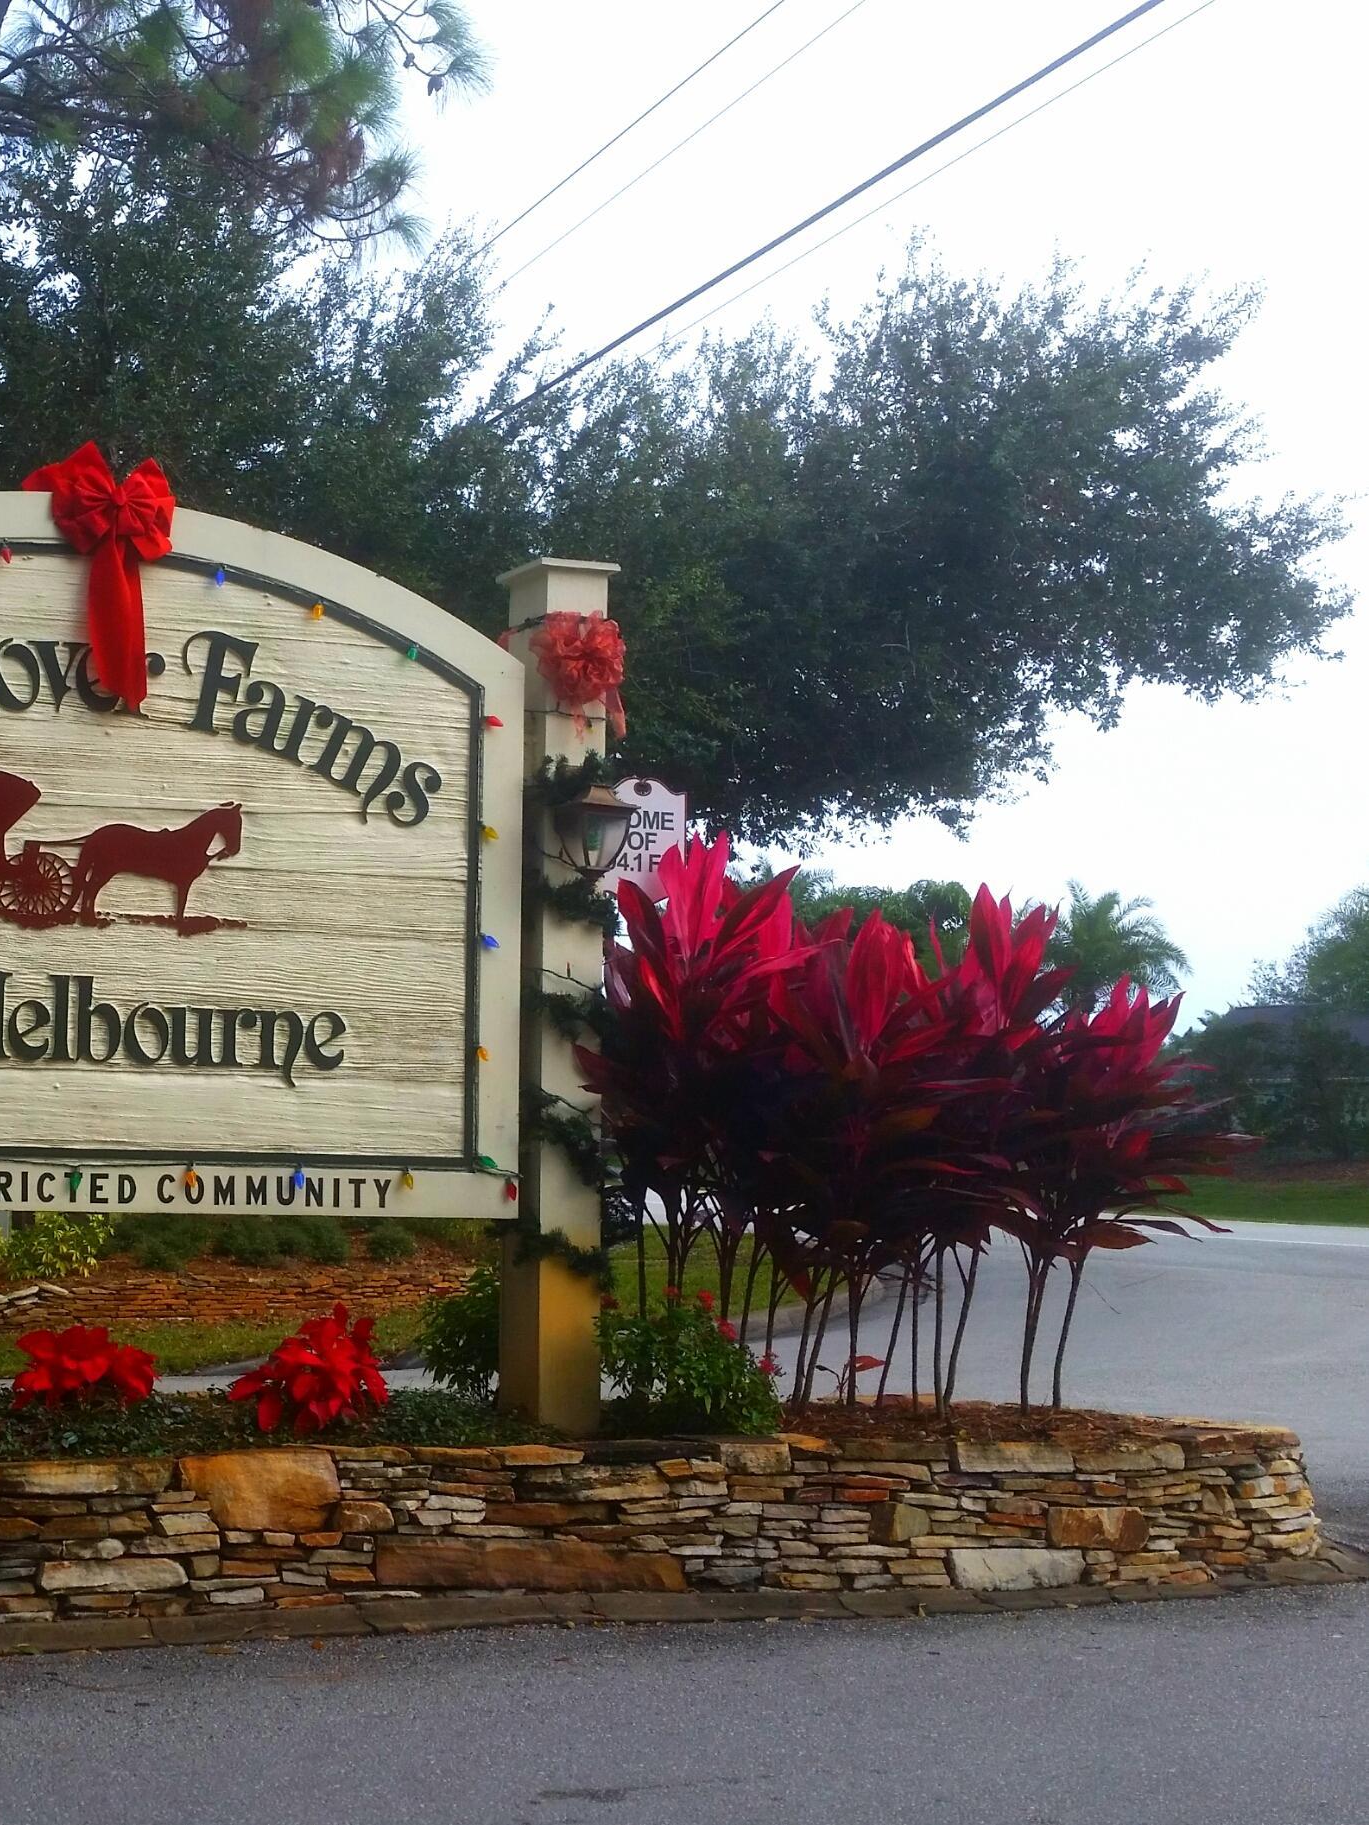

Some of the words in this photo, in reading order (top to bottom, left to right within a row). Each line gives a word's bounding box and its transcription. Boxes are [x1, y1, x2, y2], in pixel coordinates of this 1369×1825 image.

[181, 629, 442, 828] Farms
[629, 810, 675, 831] OME
[627, 831, 658, 851] OF
[614, 852, 642, 873] 4.1
[157, 1173, 392, 1209] COMMUNITY
